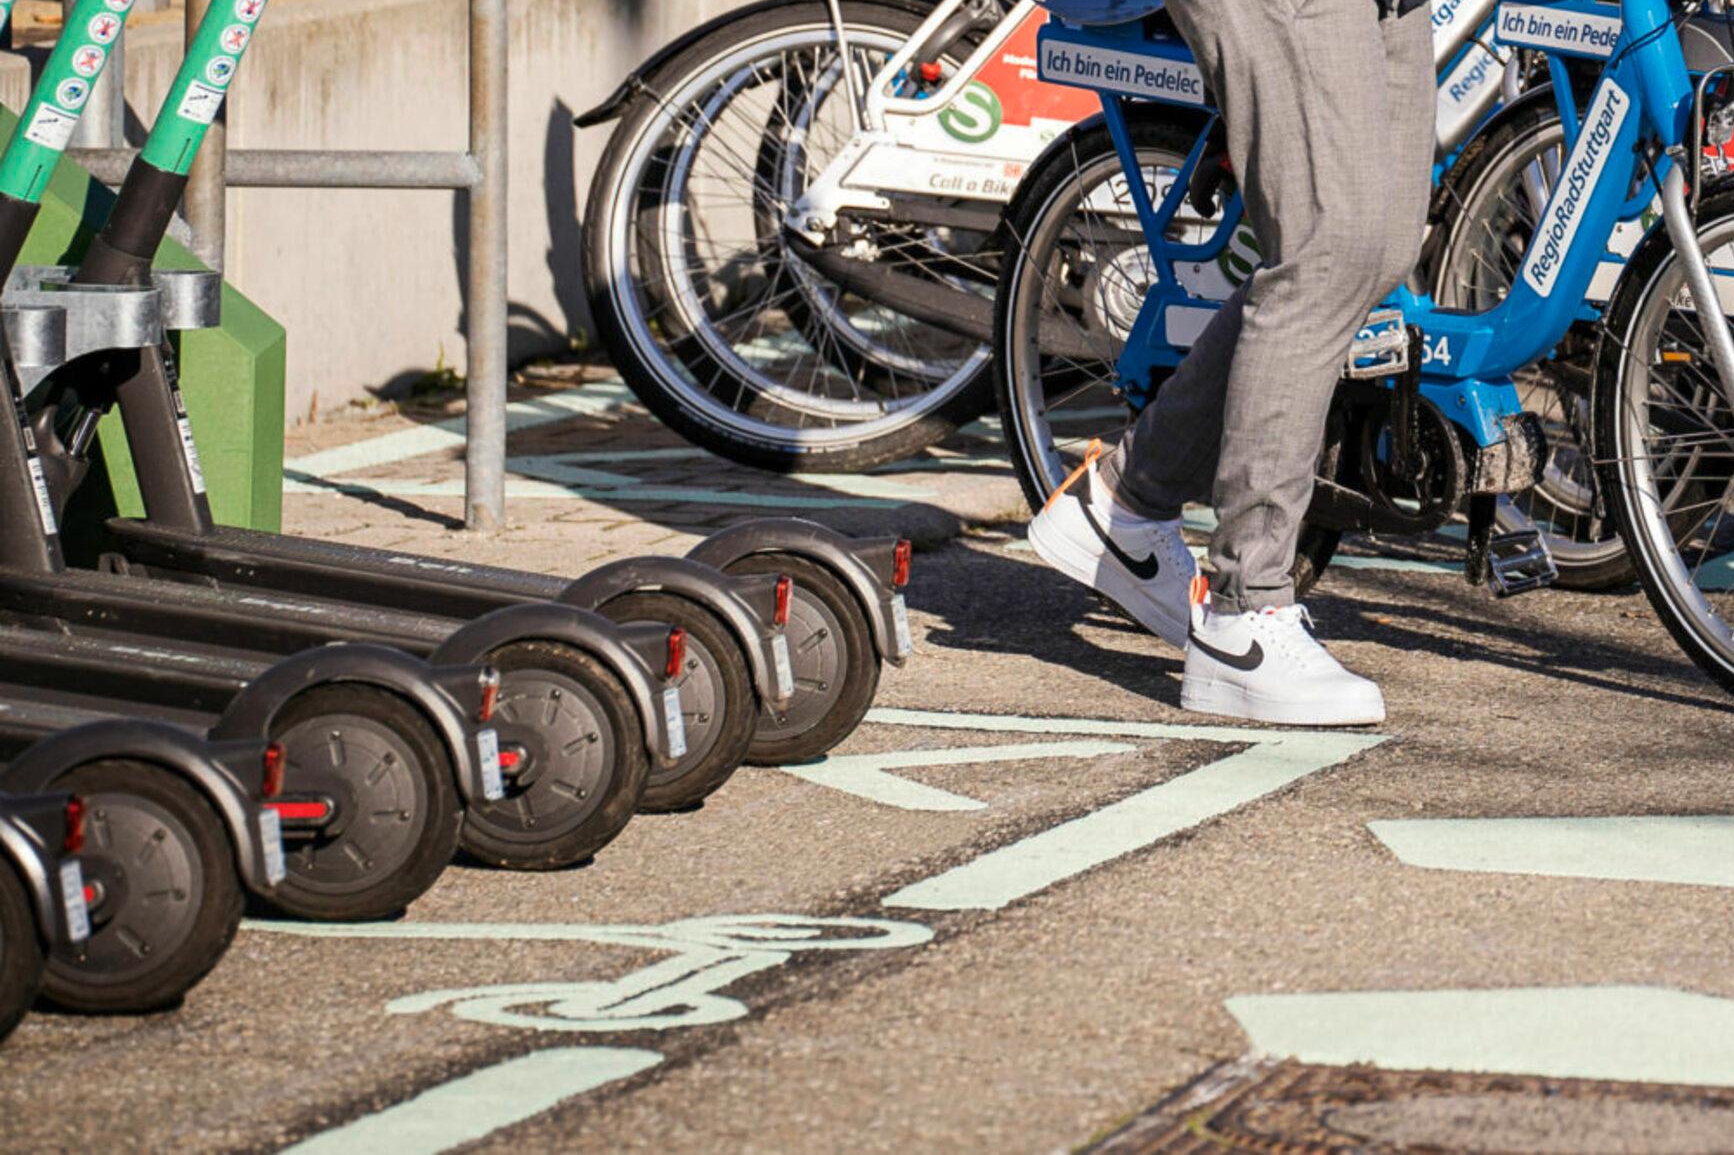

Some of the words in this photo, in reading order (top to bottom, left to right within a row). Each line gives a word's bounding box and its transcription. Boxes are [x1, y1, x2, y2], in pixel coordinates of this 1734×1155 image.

[1502, 11, 1525, 33] Ich
[1527, 15, 1552, 38] bin
[1554, 21, 1578, 42] ein
[1046, 50, 1071, 73] Ich
[1074, 52, 1101, 78] bin
[1104, 60, 1131, 84] ein
[1133, 63, 1200, 96] Pedelec
[929, 172, 962, 190] Call
[966, 180, 977, 191] a
[1529, 89, 1621, 287] RegioRadStuttgart
